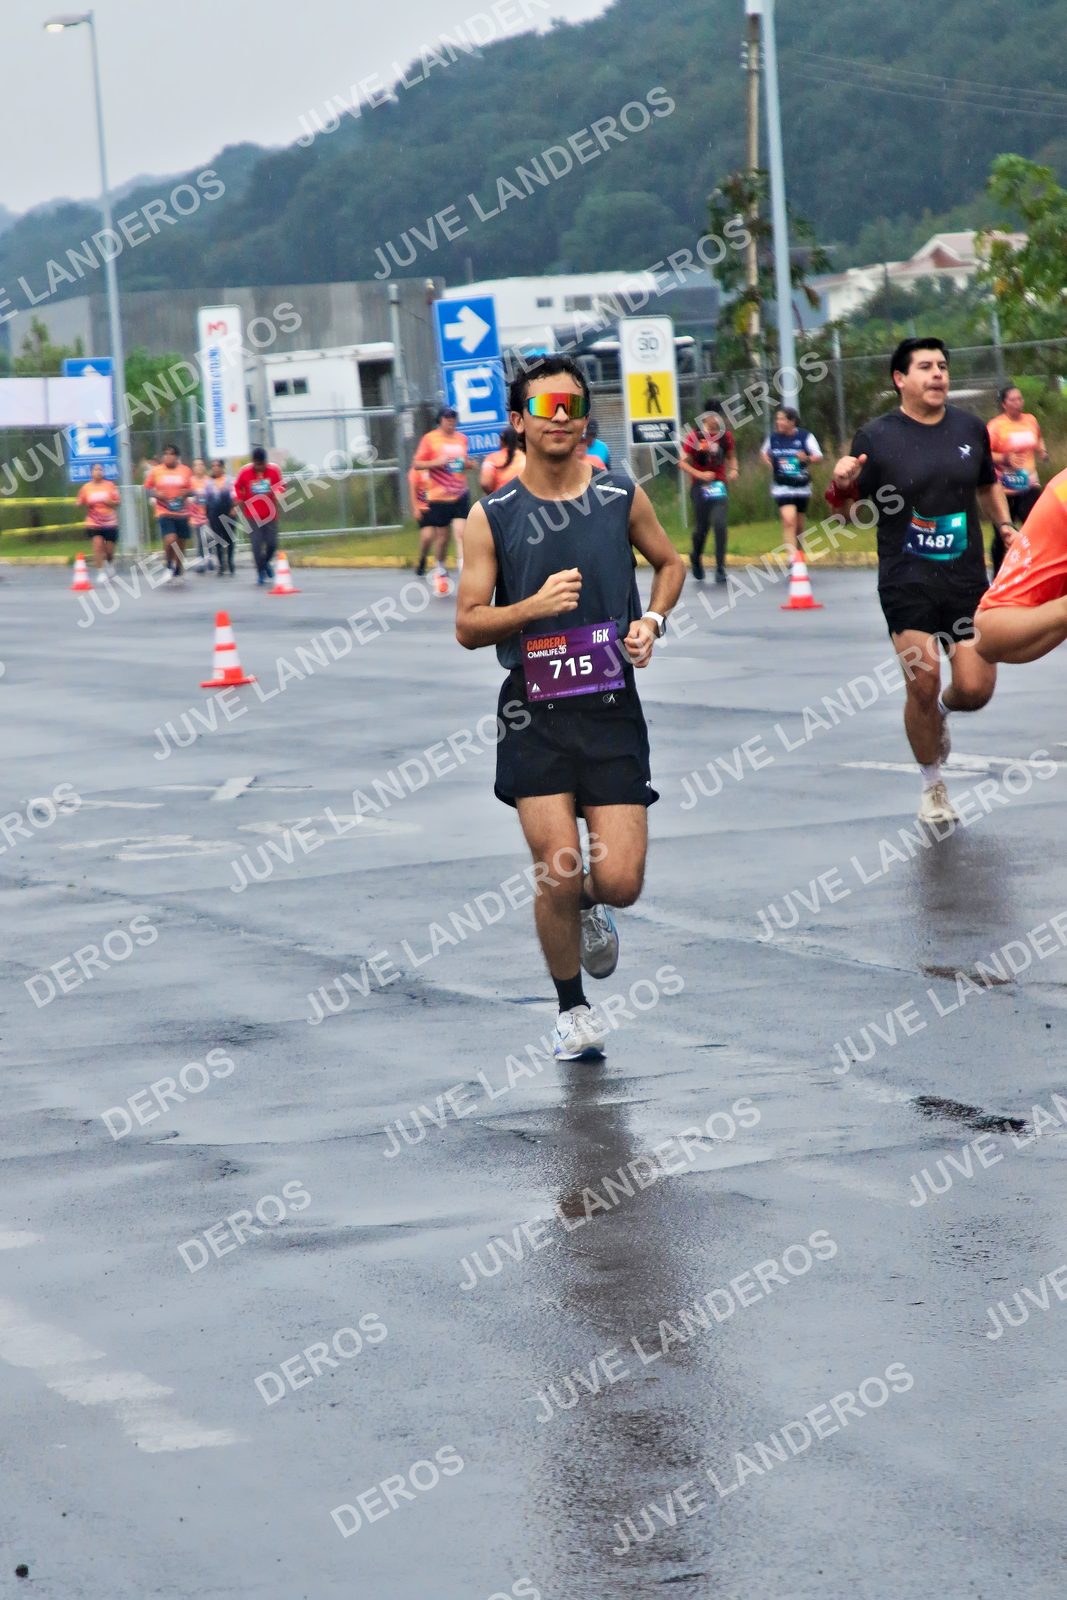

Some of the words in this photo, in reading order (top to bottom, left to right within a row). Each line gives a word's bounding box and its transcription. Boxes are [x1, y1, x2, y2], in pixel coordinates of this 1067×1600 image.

[638, 337, 659, 350] 30
[453, 367, 498, 423] E
[917, 533, 955, 549] 1487
[527, 636, 567, 652] CARRERA
[592, 628, 610, 644] 16K
[549, 655, 593, 679] 715
